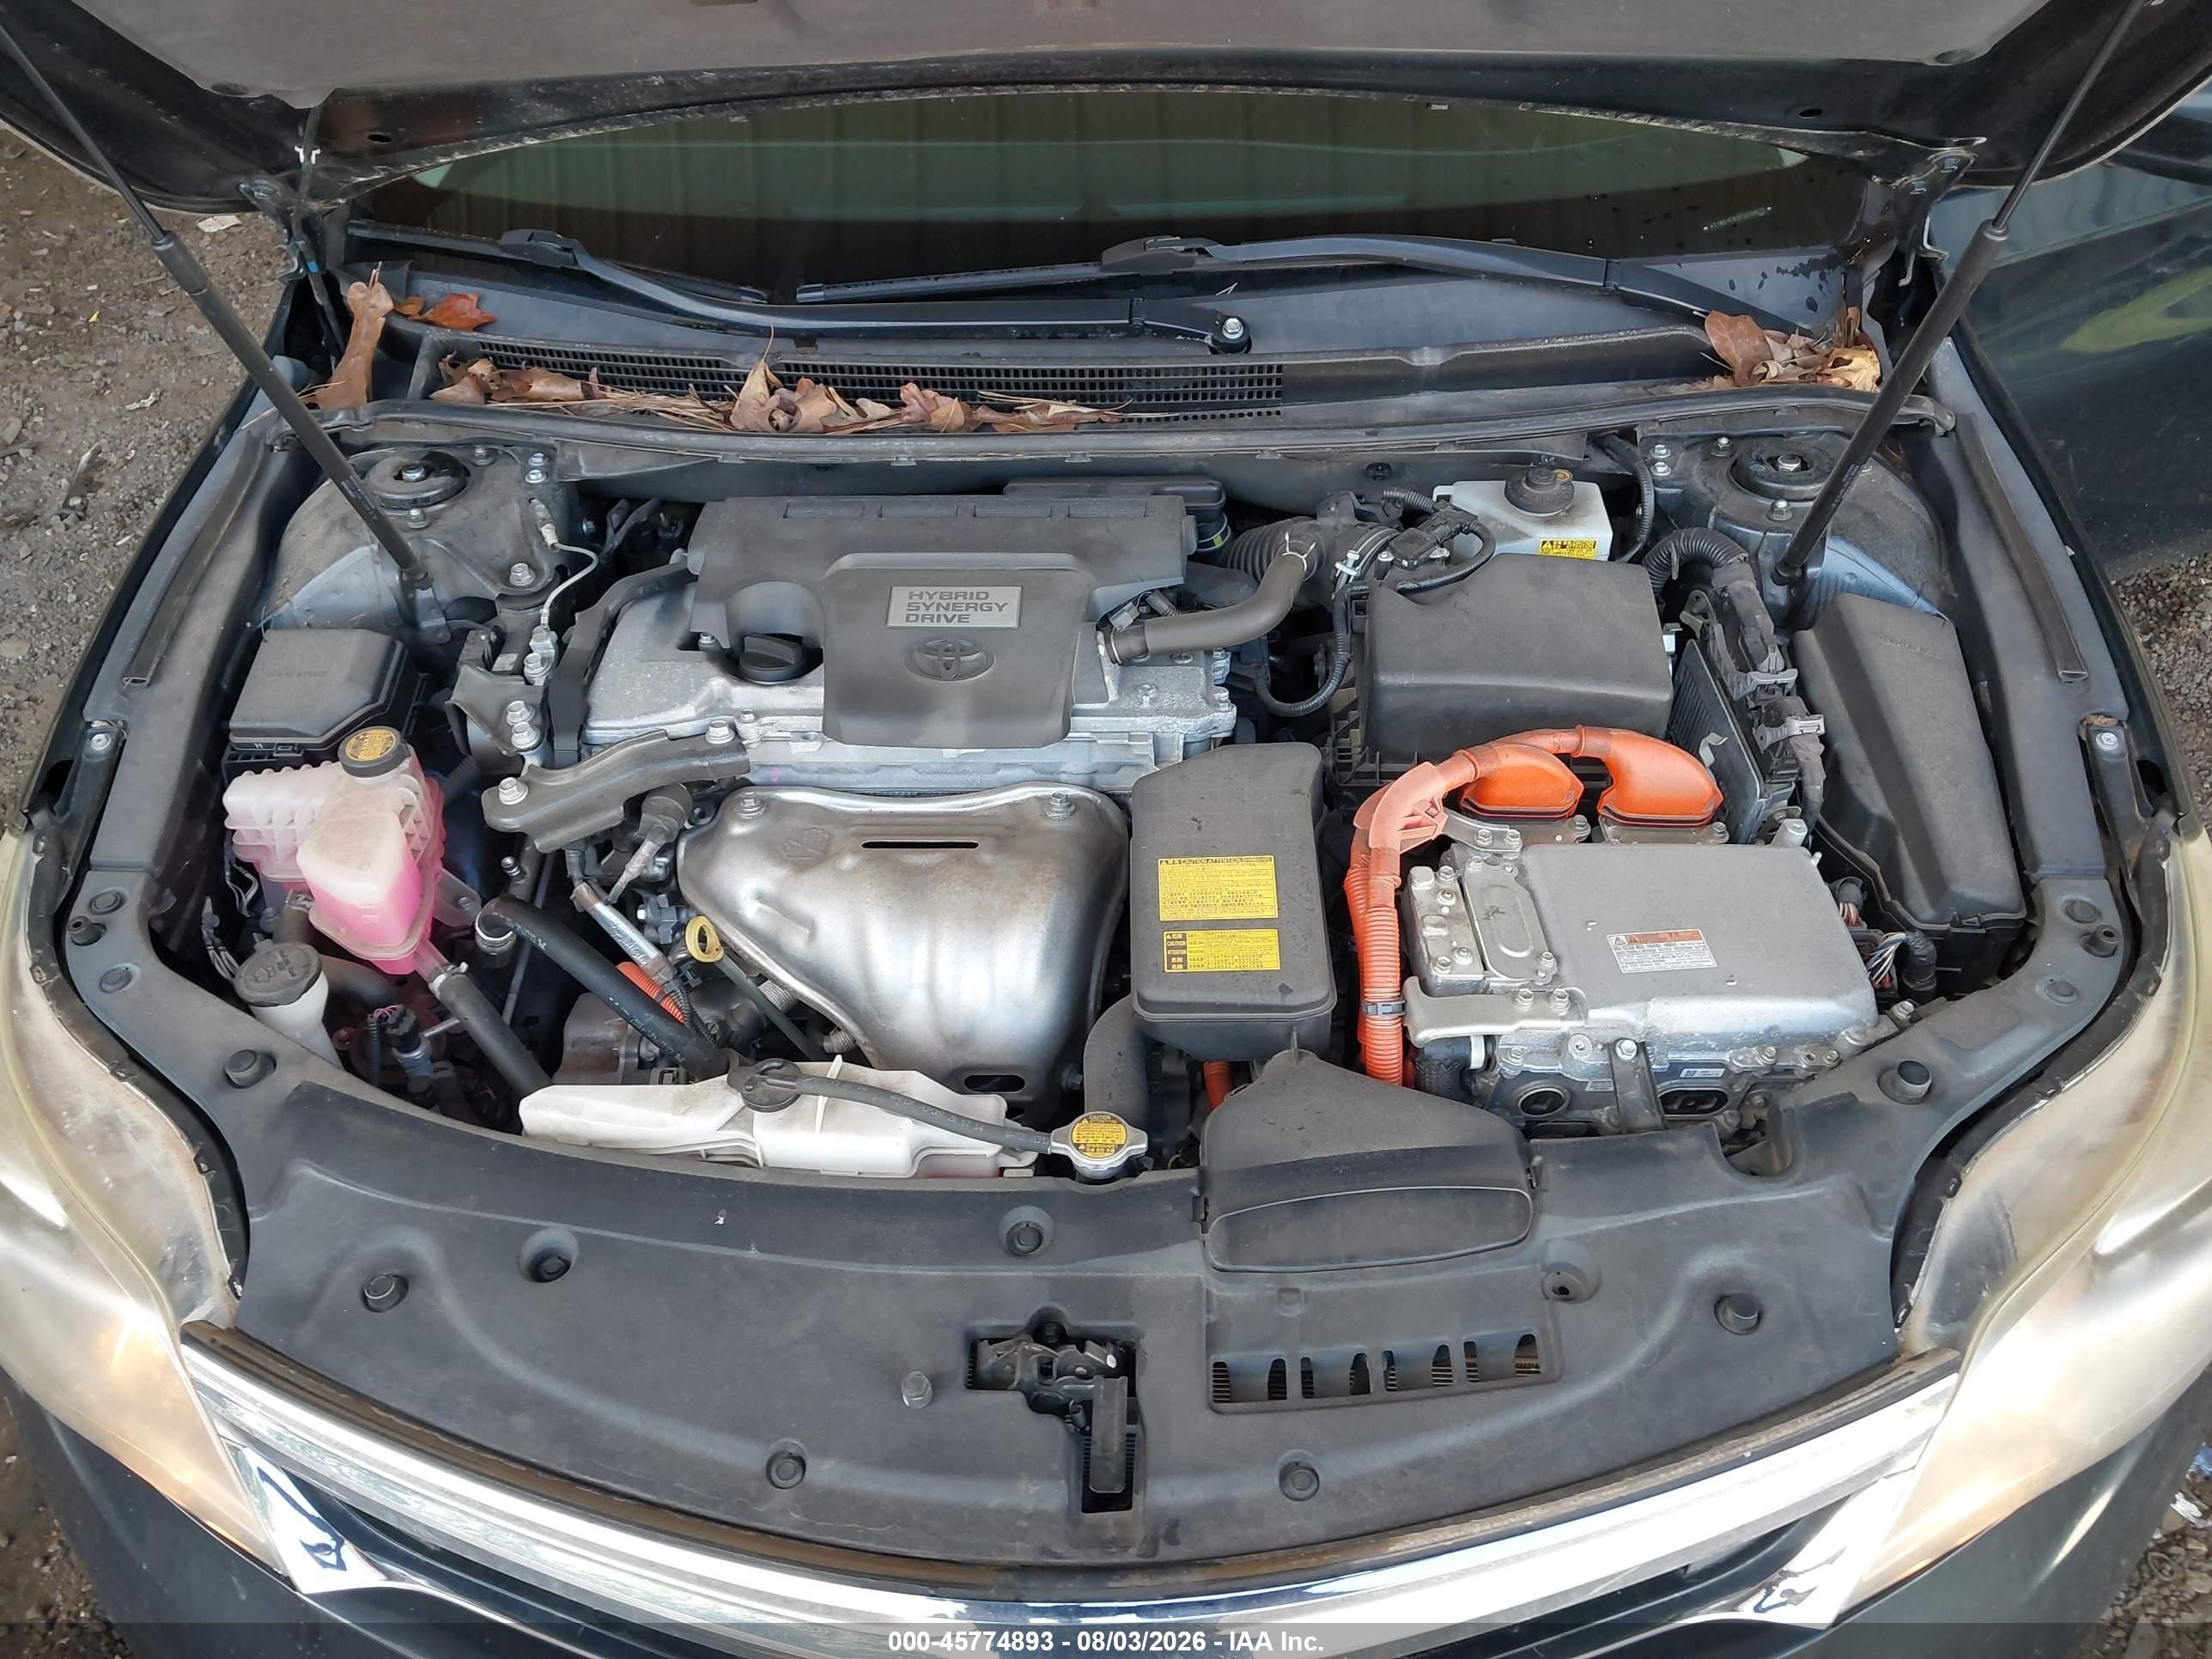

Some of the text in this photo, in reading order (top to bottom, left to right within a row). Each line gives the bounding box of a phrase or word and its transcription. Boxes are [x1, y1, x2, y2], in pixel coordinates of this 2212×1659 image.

[908, 591, 990, 600] HYBRID
[906, 602, 1009, 612] SYNERGY
[905, 613, 971, 623] DRIVE
